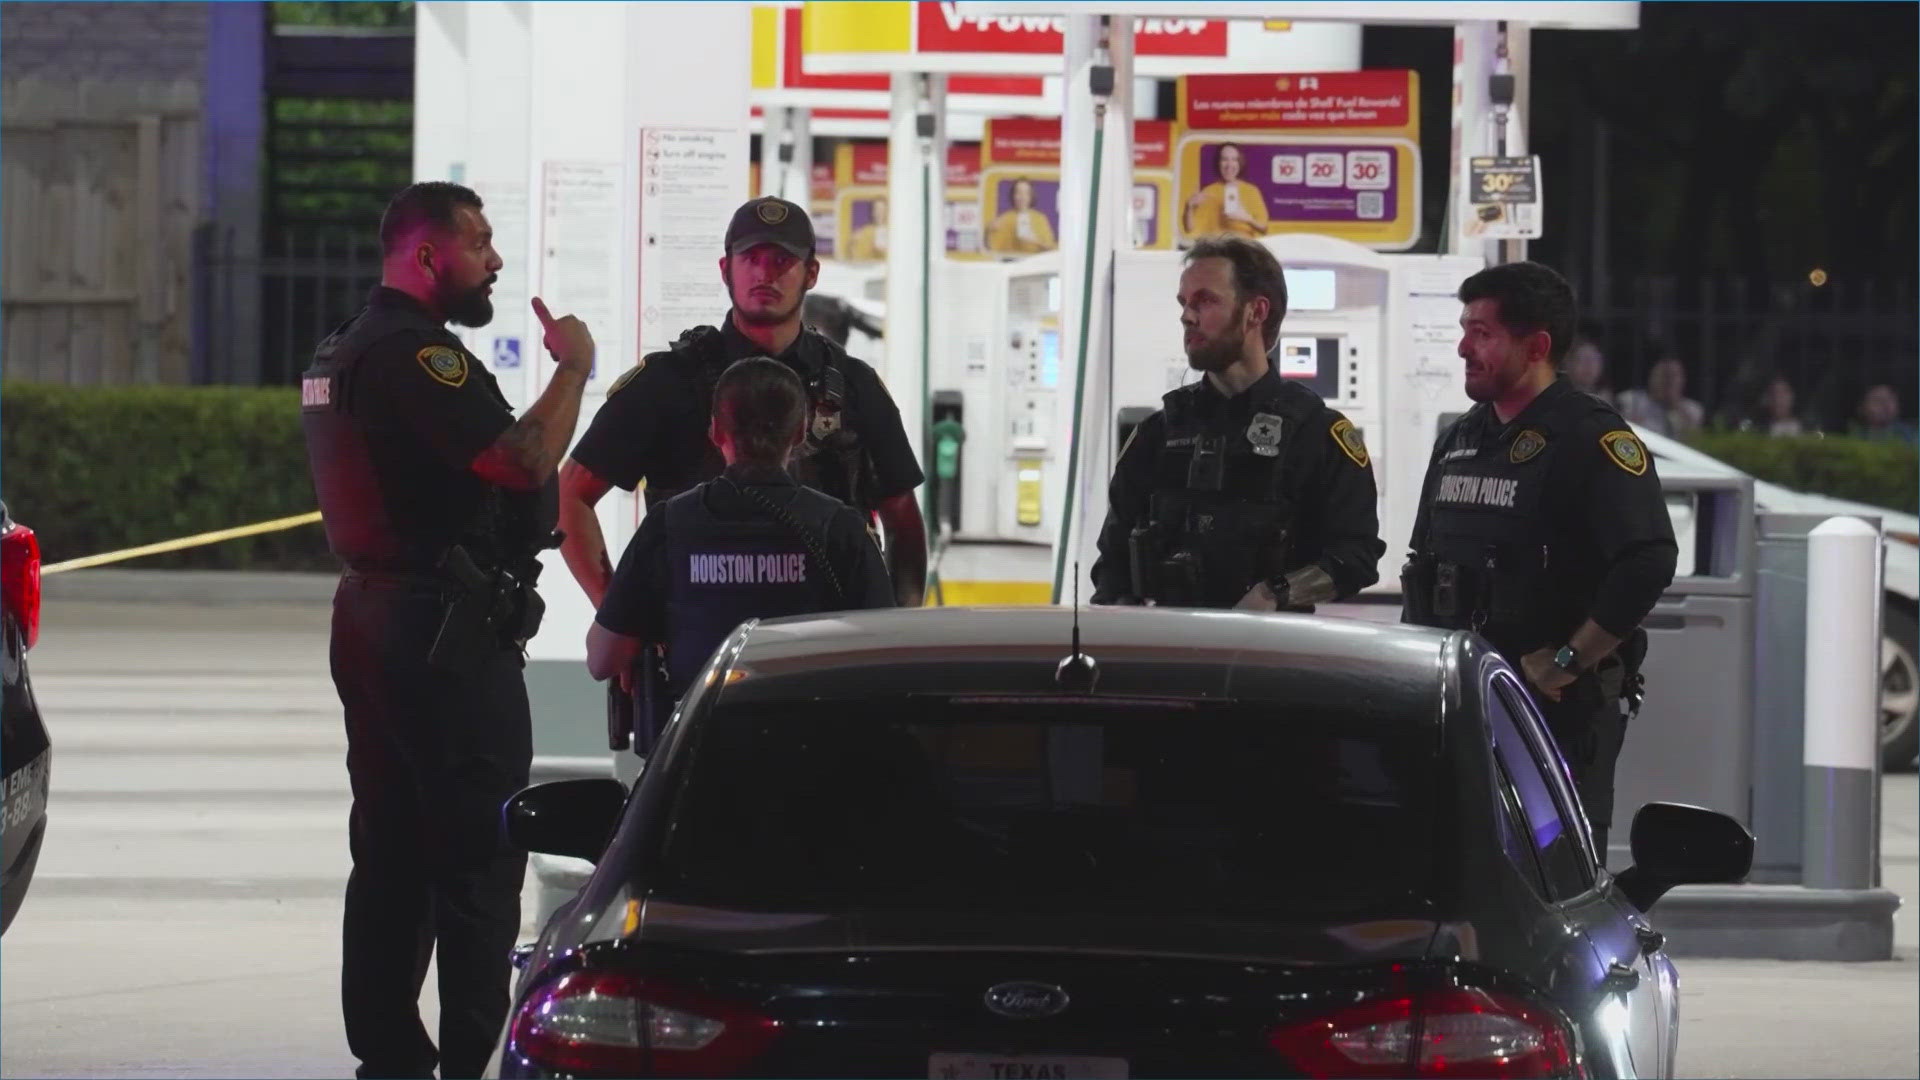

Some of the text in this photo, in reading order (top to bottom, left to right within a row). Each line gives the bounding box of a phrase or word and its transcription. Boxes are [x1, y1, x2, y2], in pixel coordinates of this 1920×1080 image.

[1478, 477, 1519, 508] POLICE
[690, 553, 806, 584] HOUSTON POLICE
[989, 1063, 1066, 1080] TEXAS
